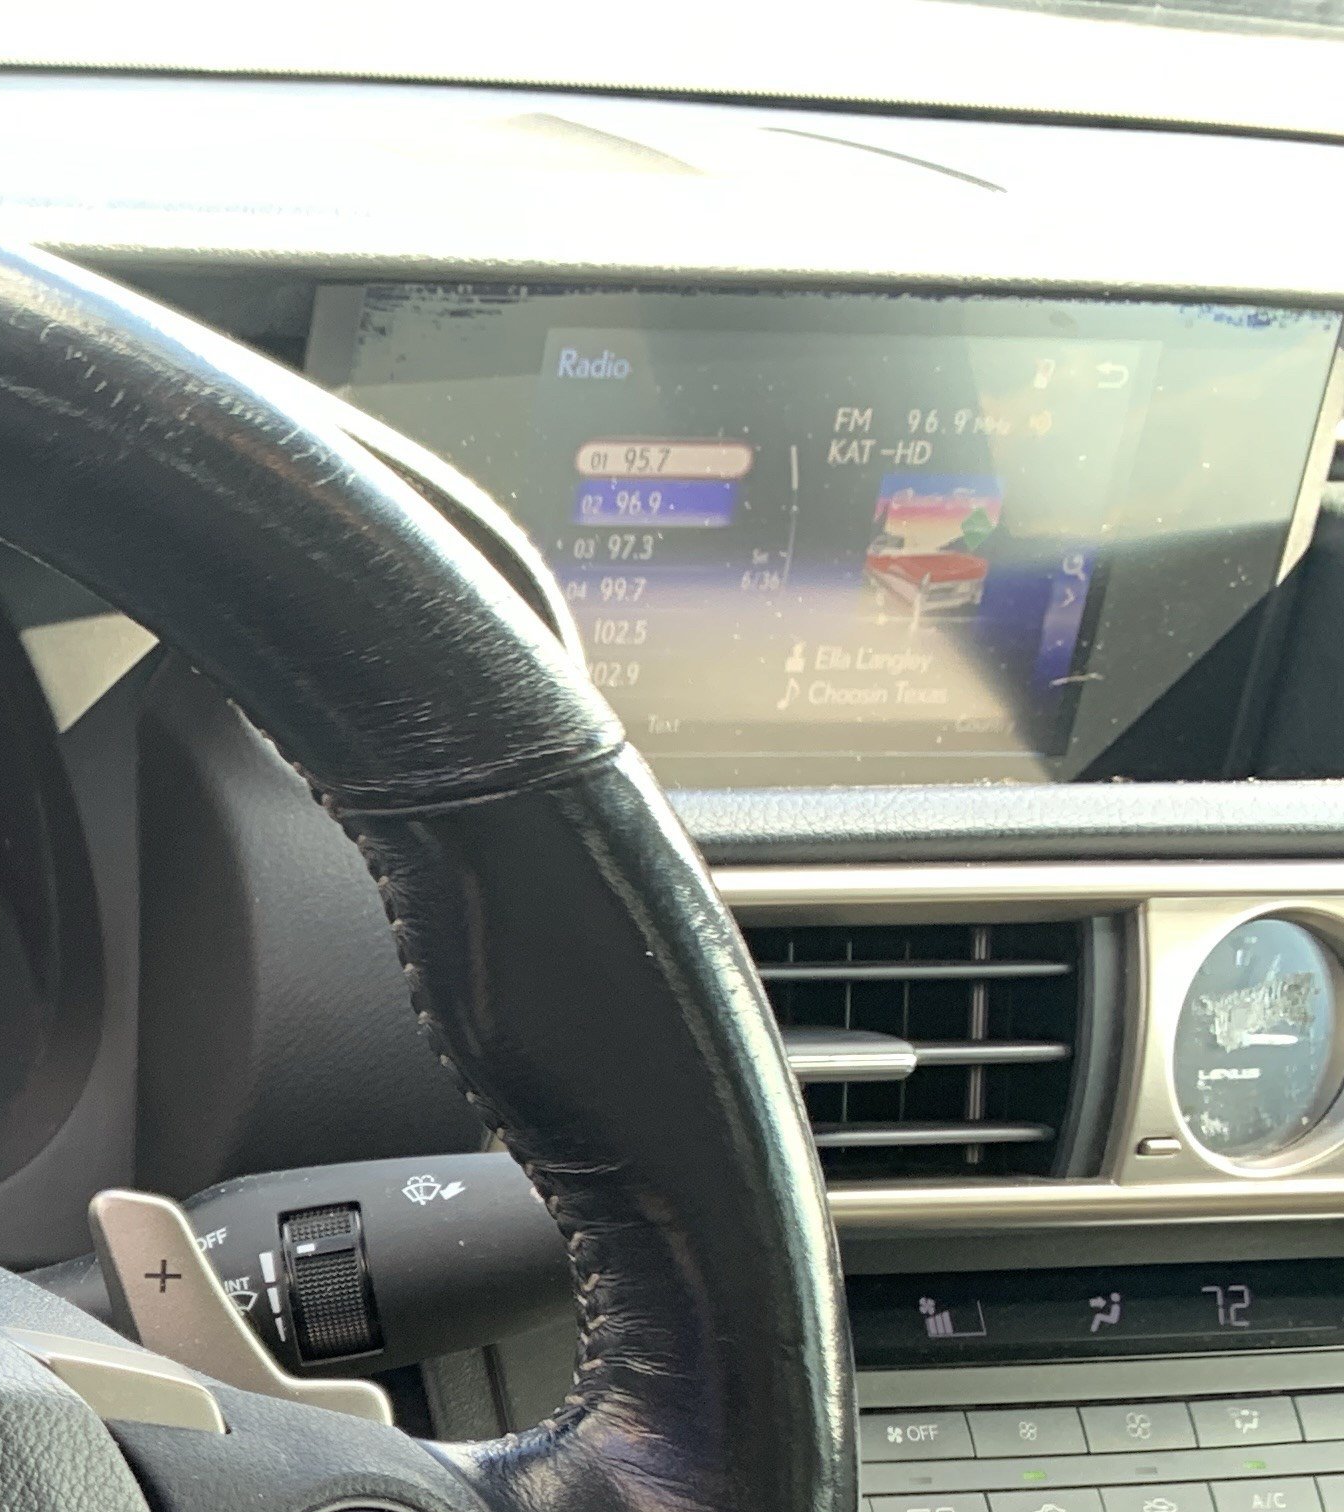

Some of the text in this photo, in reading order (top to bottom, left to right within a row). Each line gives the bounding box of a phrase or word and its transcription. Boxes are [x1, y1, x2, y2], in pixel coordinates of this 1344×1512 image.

[558, 348, 630, 378] Radio
[834, 407, 873, 433] FM
[590, 448, 671, 472] 01 95.7
[616, 491, 662, 515] 96.9
[574, 534, 654, 560] 03 97.3
[600, 577, 647, 601] 99.7
[594, 618, 648, 645] 102.5
[224, 1276, 250, 1293] INT
[1202, 1285, 1249, 1327] 72
[907, 1425, 938, 1441] OFF
[1252, 1492, 1287, 1509] A/C
